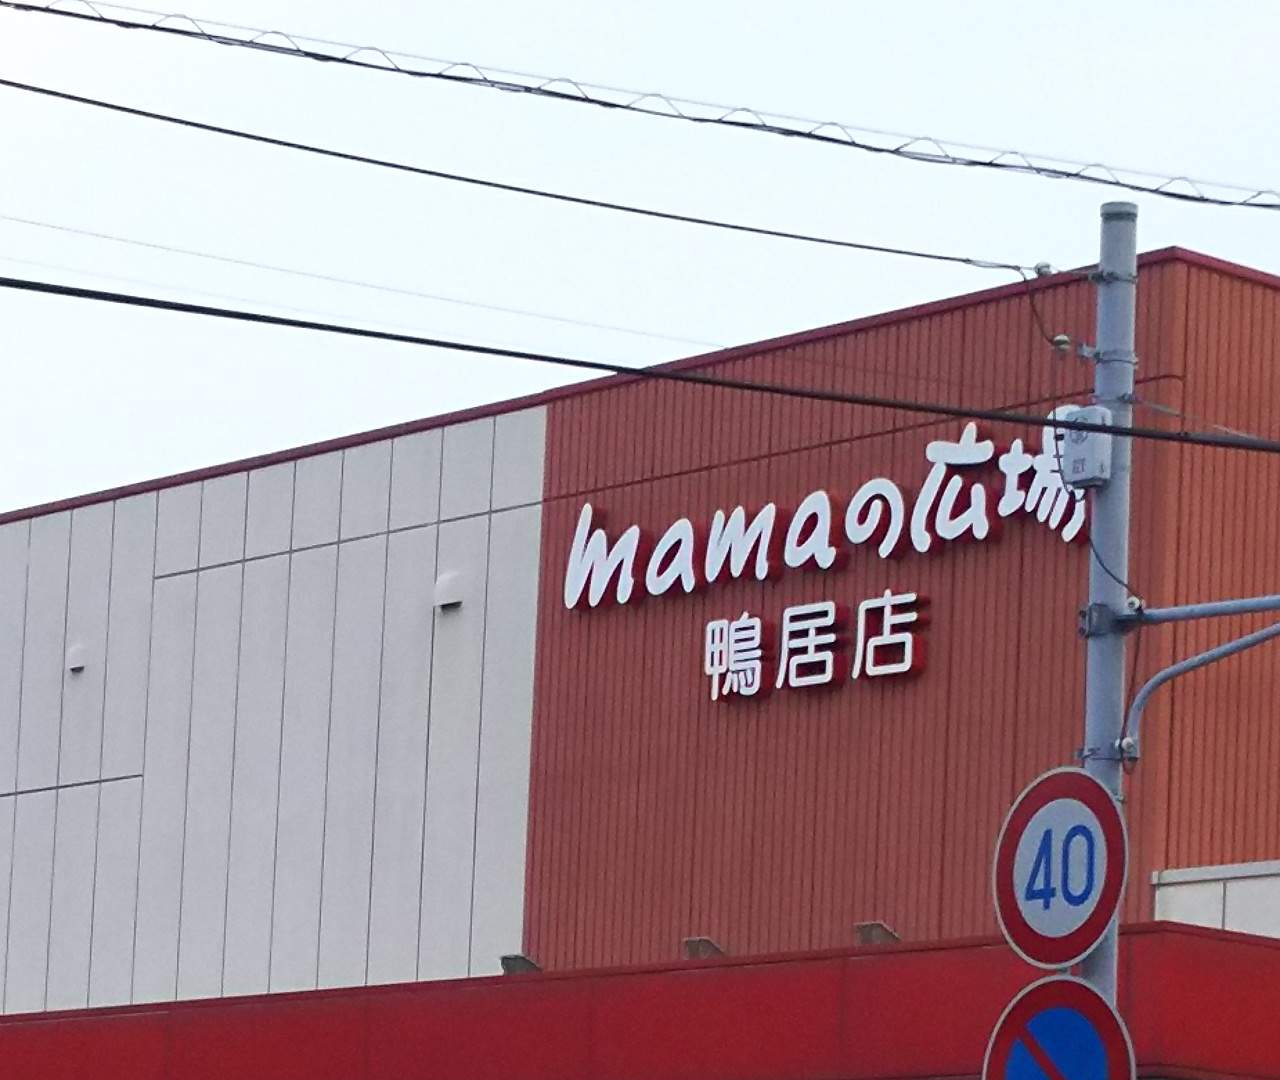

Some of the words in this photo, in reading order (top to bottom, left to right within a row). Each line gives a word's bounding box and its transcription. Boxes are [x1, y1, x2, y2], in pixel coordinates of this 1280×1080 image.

[564, 404, 1088, 609] mamaの広場
[705, 588, 918, 700] 鴨居店
[1024, 824, 1096, 909] 40
